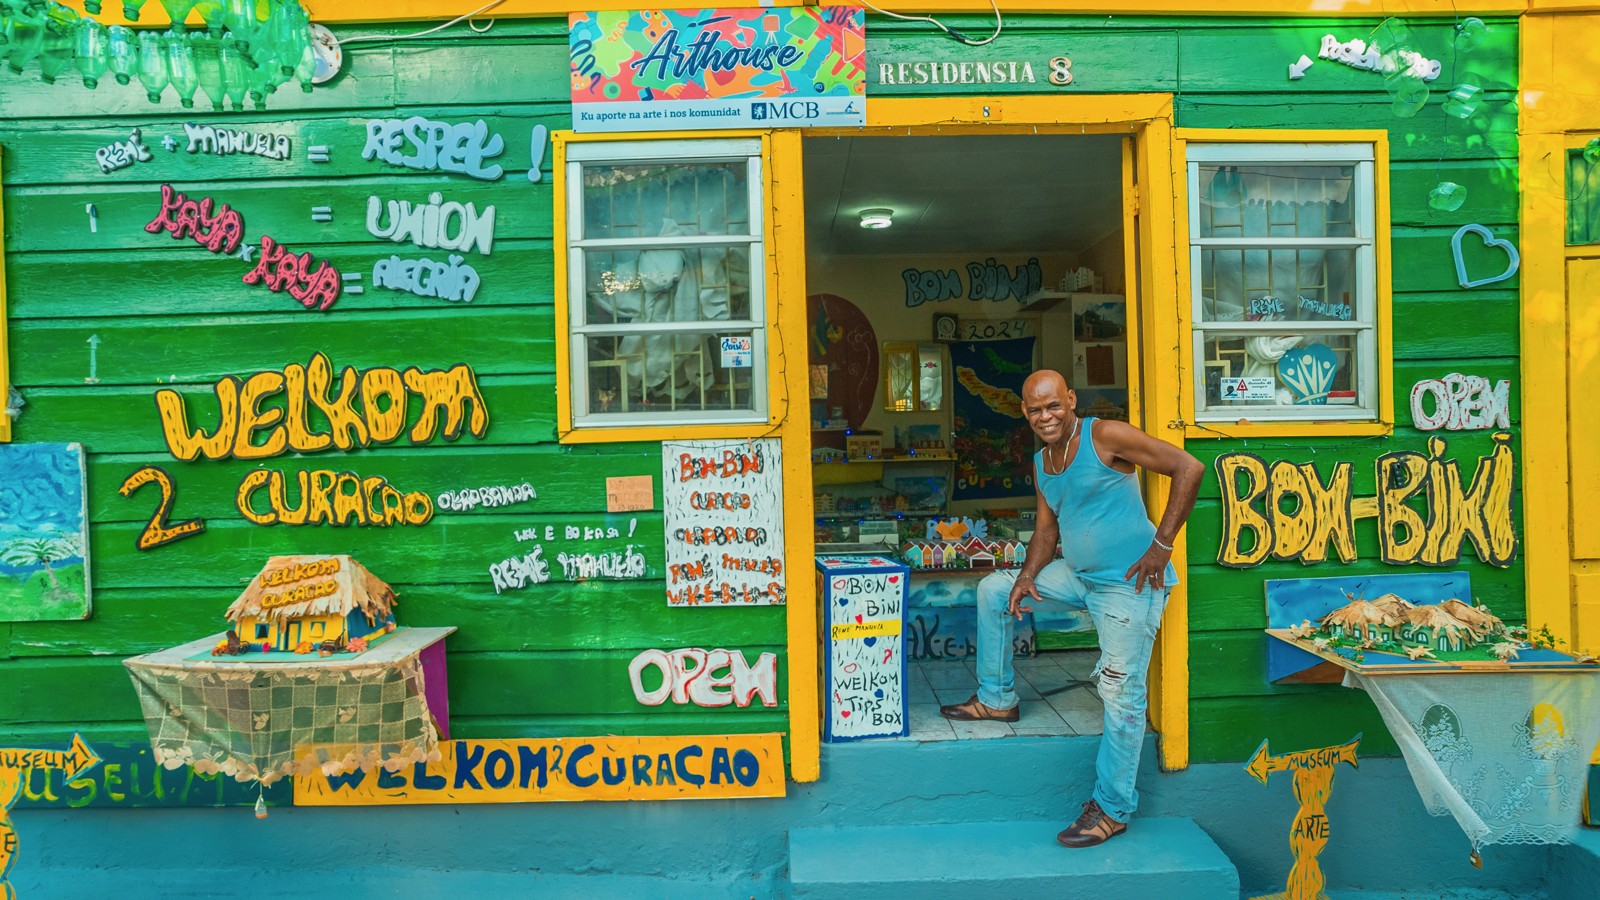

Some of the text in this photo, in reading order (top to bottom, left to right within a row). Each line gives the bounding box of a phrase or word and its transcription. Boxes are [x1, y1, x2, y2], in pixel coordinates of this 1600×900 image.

[631, 29, 804, 80] Arthouse
[879, 57, 1073, 86] RESIDENSIA 8
[581, 111, 594, 121] Ku
[596, 111, 626, 122] aporte
[643, 111, 662, 120] arte
[670, 111, 687, 119] nos
[689, 108, 741, 118] komunidat
[769, 102, 819, 120] MCB
[982, 106, 991, 118] 8
[183, 121, 291, 160] MANUELA
[144, 183, 243, 253] KAYA
[242, 235, 340, 311] KAYA
[154, 351, 489, 461] WELKOM
[1410, 372, 1511, 431] OPEN
[119, 465, 206, 550] 2
[545, 525, 554, 541] E
[565, 525, 580, 540] BO
[260, 558, 340, 589] WELKOM
[849, 575, 887, 595] BON
[628, 648, 778, 708] OPEN
[872, 709, 902, 726] BOX
[0, 751, 78, 772] USEUM
[1287, 748, 1340, 770] MUSEUM
[1295, 814, 1330, 841] ARTE
